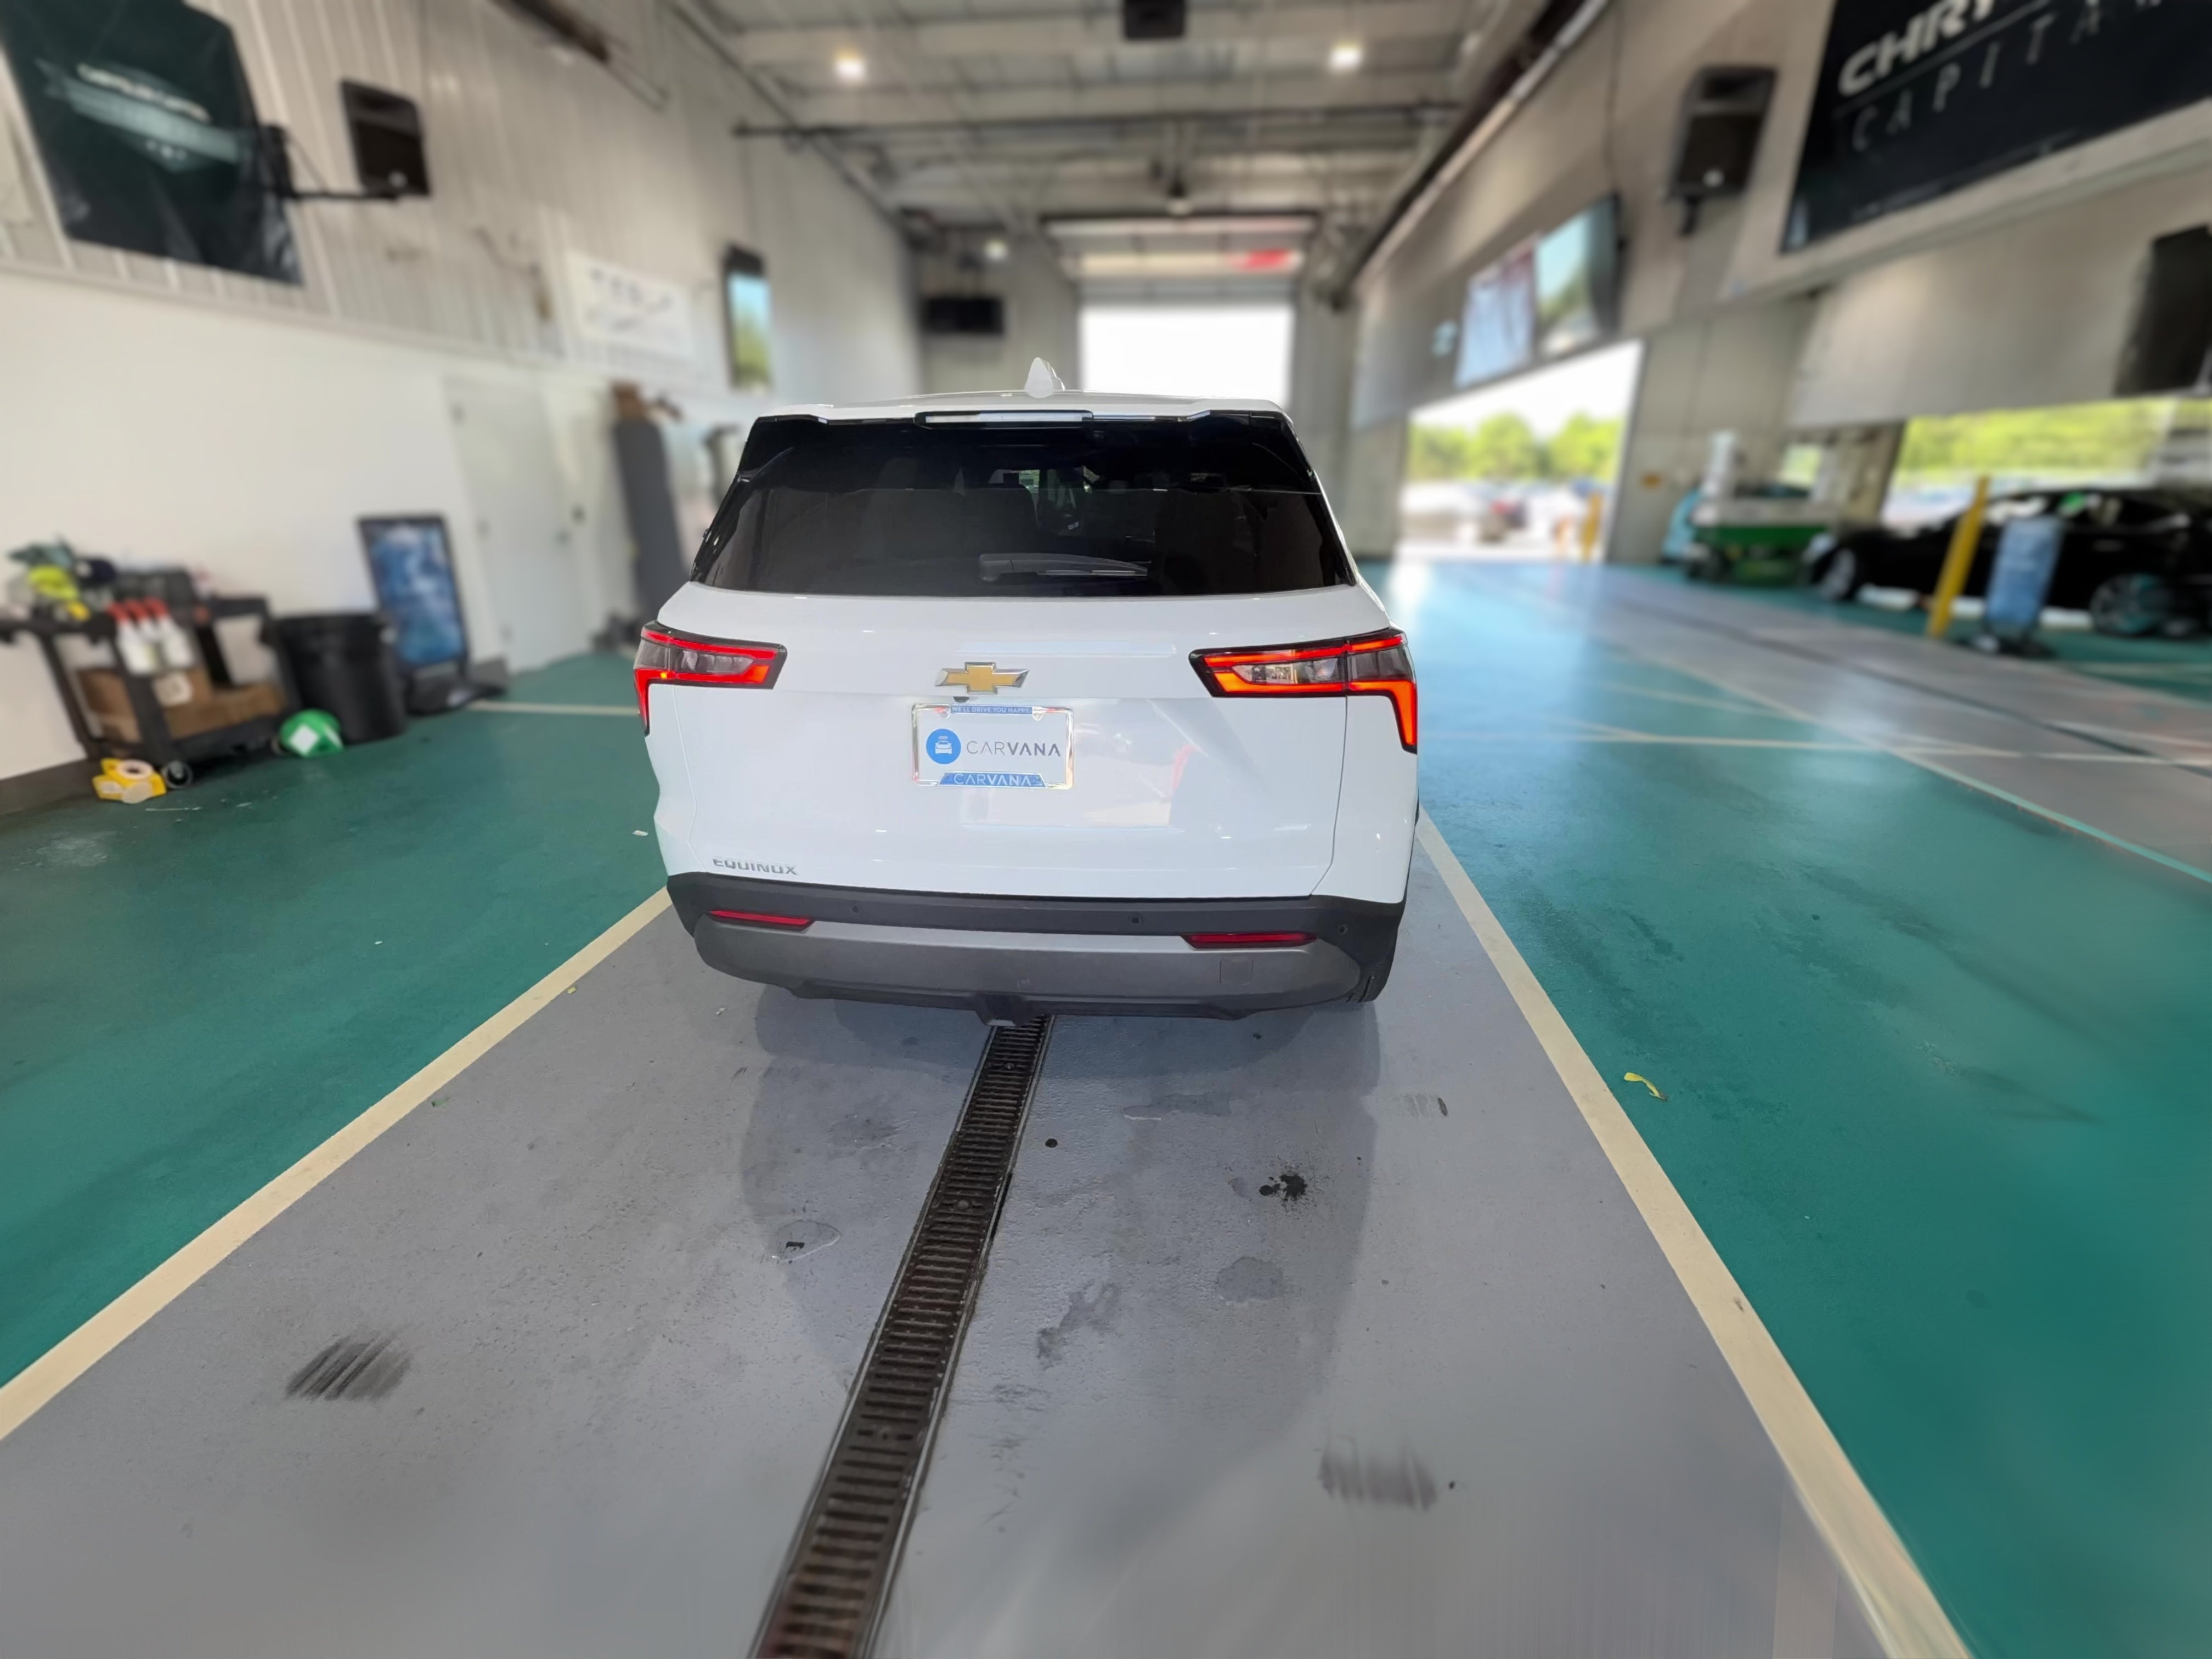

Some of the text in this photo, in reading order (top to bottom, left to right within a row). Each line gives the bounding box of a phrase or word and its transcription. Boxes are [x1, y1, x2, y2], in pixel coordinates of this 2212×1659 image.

[1851, 0, 2160, 152] CAPITA
[966, 741, 1061, 757] CARVANA
[953, 774, 1032, 786] CARVANA
[713, 857, 797, 876] EQUINOX
